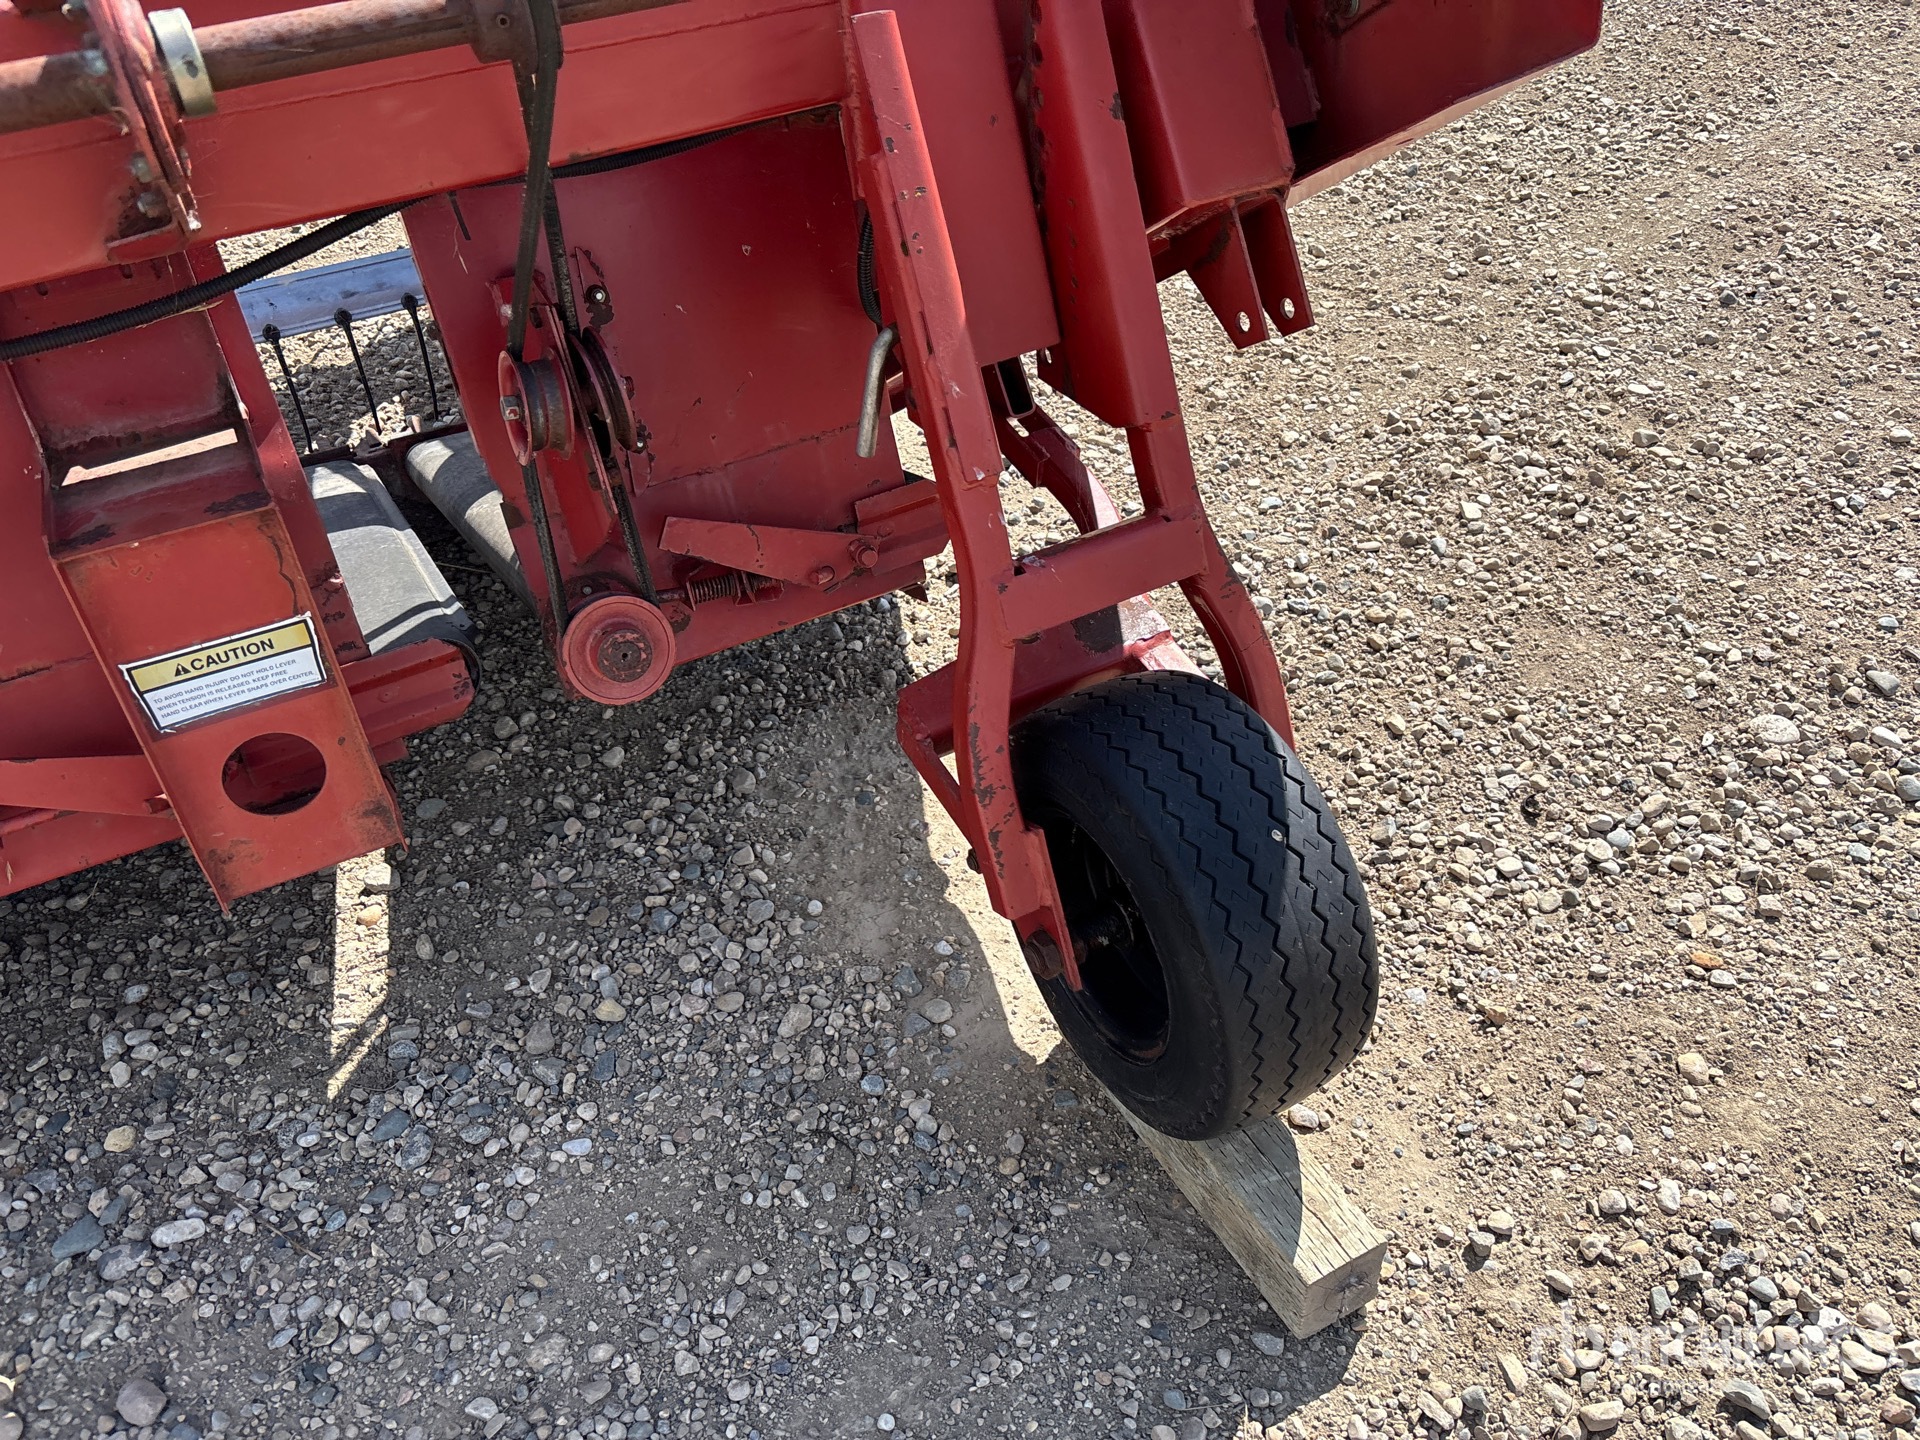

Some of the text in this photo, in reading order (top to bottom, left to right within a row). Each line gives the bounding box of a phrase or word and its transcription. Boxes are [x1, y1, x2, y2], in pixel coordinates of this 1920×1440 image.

[191, 638, 274, 671] CAUTION
[154, 697, 163, 705] TO
[164, 691, 184, 703] AVOID
[185, 685, 204, 696] HAND
[205, 679, 228, 691] INJURY
[242, 671, 255, 679] NOT
[256, 665, 274, 675] HOLD
[275, 659, 297, 669] LEVER
[158, 703, 178, 712] WHEN
[179, 694, 207, 707] TENSION
[252, 674, 270, 684] KEEP
[270, 669, 288, 679] FREE
[162, 709, 180, 719] HAND
[182, 702, 203, 714] CLEAR
[204, 696, 224, 707] WHEN
[224, 689, 246, 700] LEVER
[247, 683, 269, 693] SNAPS
[270, 677, 287, 688] OVER
